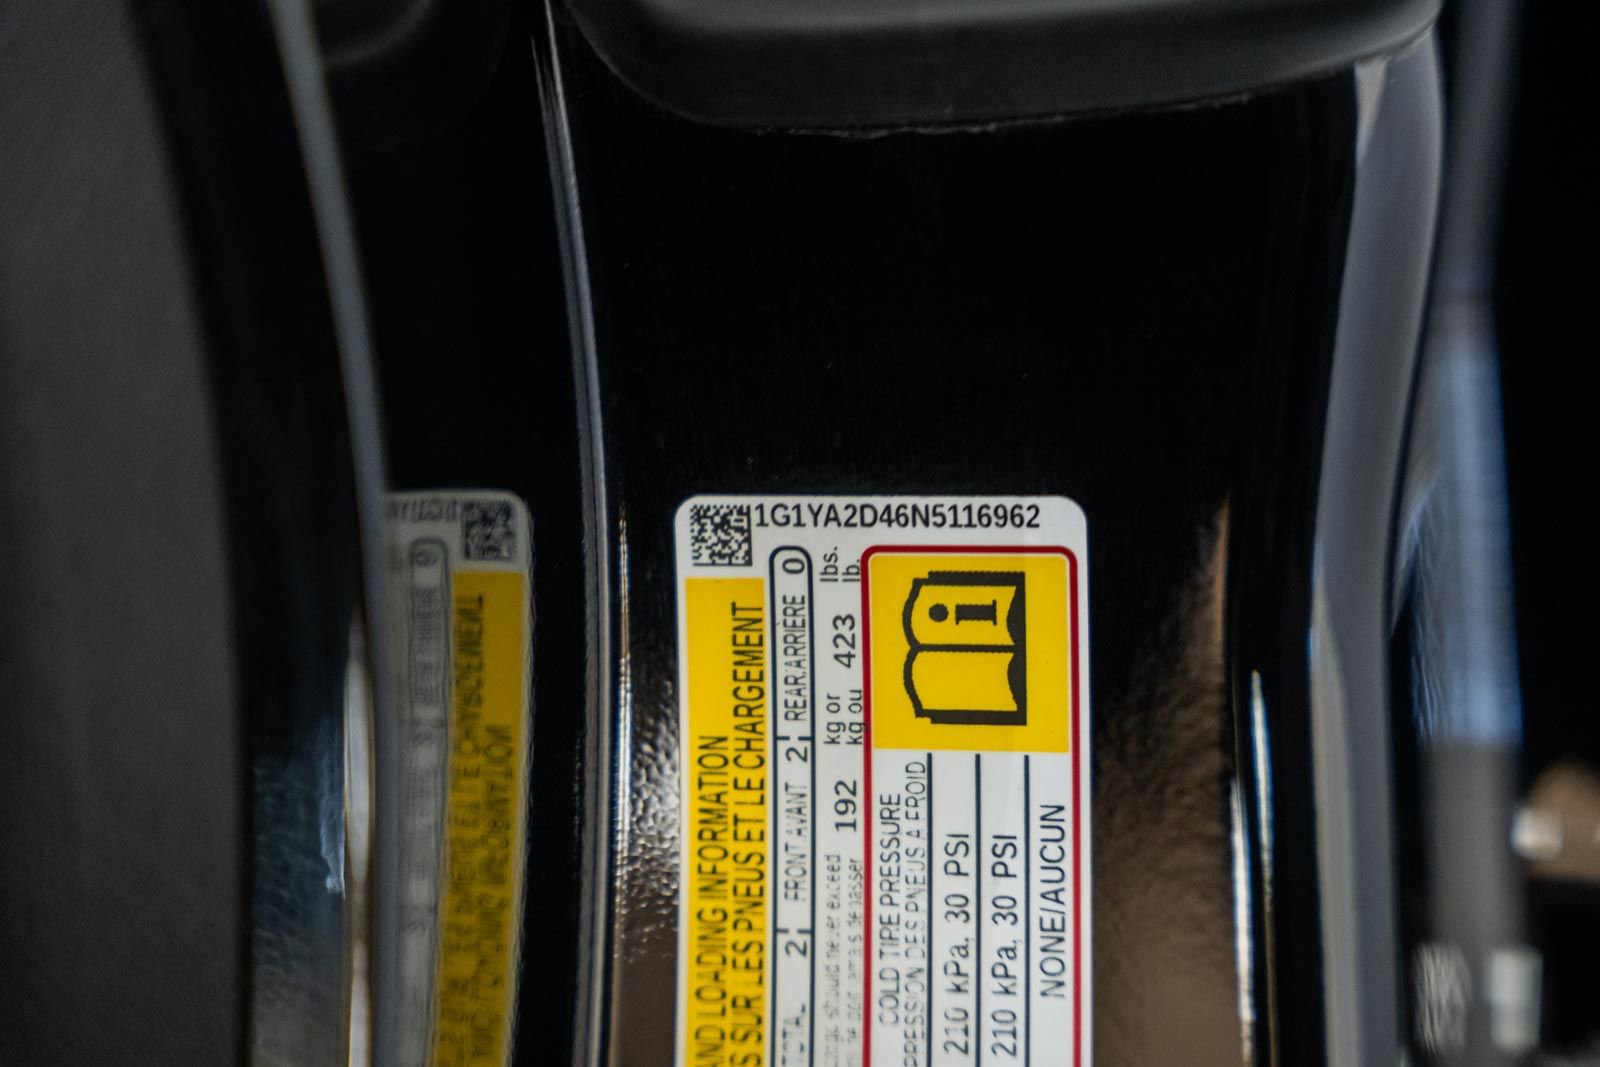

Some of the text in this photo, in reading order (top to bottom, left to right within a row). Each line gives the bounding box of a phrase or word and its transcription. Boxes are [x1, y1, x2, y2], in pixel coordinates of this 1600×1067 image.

[754, 502, 1041, 529] 1G1YA2D46N5116962
[819, 546, 838, 582] lbs.
[842, 559, 861, 582] lb.
[832, 614, 856, 668] 423
[731, 602, 764, 770] CHARGEMENT
[823, 693, 846, 745] kg or
[846, 689, 866, 745] kg ou
[785, 746, 808, 763] 2
[733, 777, 764, 806] LE
[833, 780, 857, 832] 192
[904, 761, 926, 821] FROID
[697, 735, 728, 899] INFORMATION
[733, 814, 764, 842] ET
[879, 793, 900, 906] PRESSURE
[944, 833, 970, 877] PSI
[992, 834, 1018, 879] PSI
[732, 851, 764, 931] PNEUS
[904, 847, 926, 912] PNEUS
[1039, 804, 1066, 999] NONE/AUCUN
[944, 893, 970, 924] 30
[991, 894, 1018, 926] 30
[694, 907, 728, 1017] LOADING
[731, 940, 764, 986] LES
[784, 940, 807, 958] 2
[729, 995, 762, 1044] SUR
[878, 967, 900, 1025] COLD
[942, 1008, 970, 1056] 210
[990, 1009, 1018, 1058] 210
